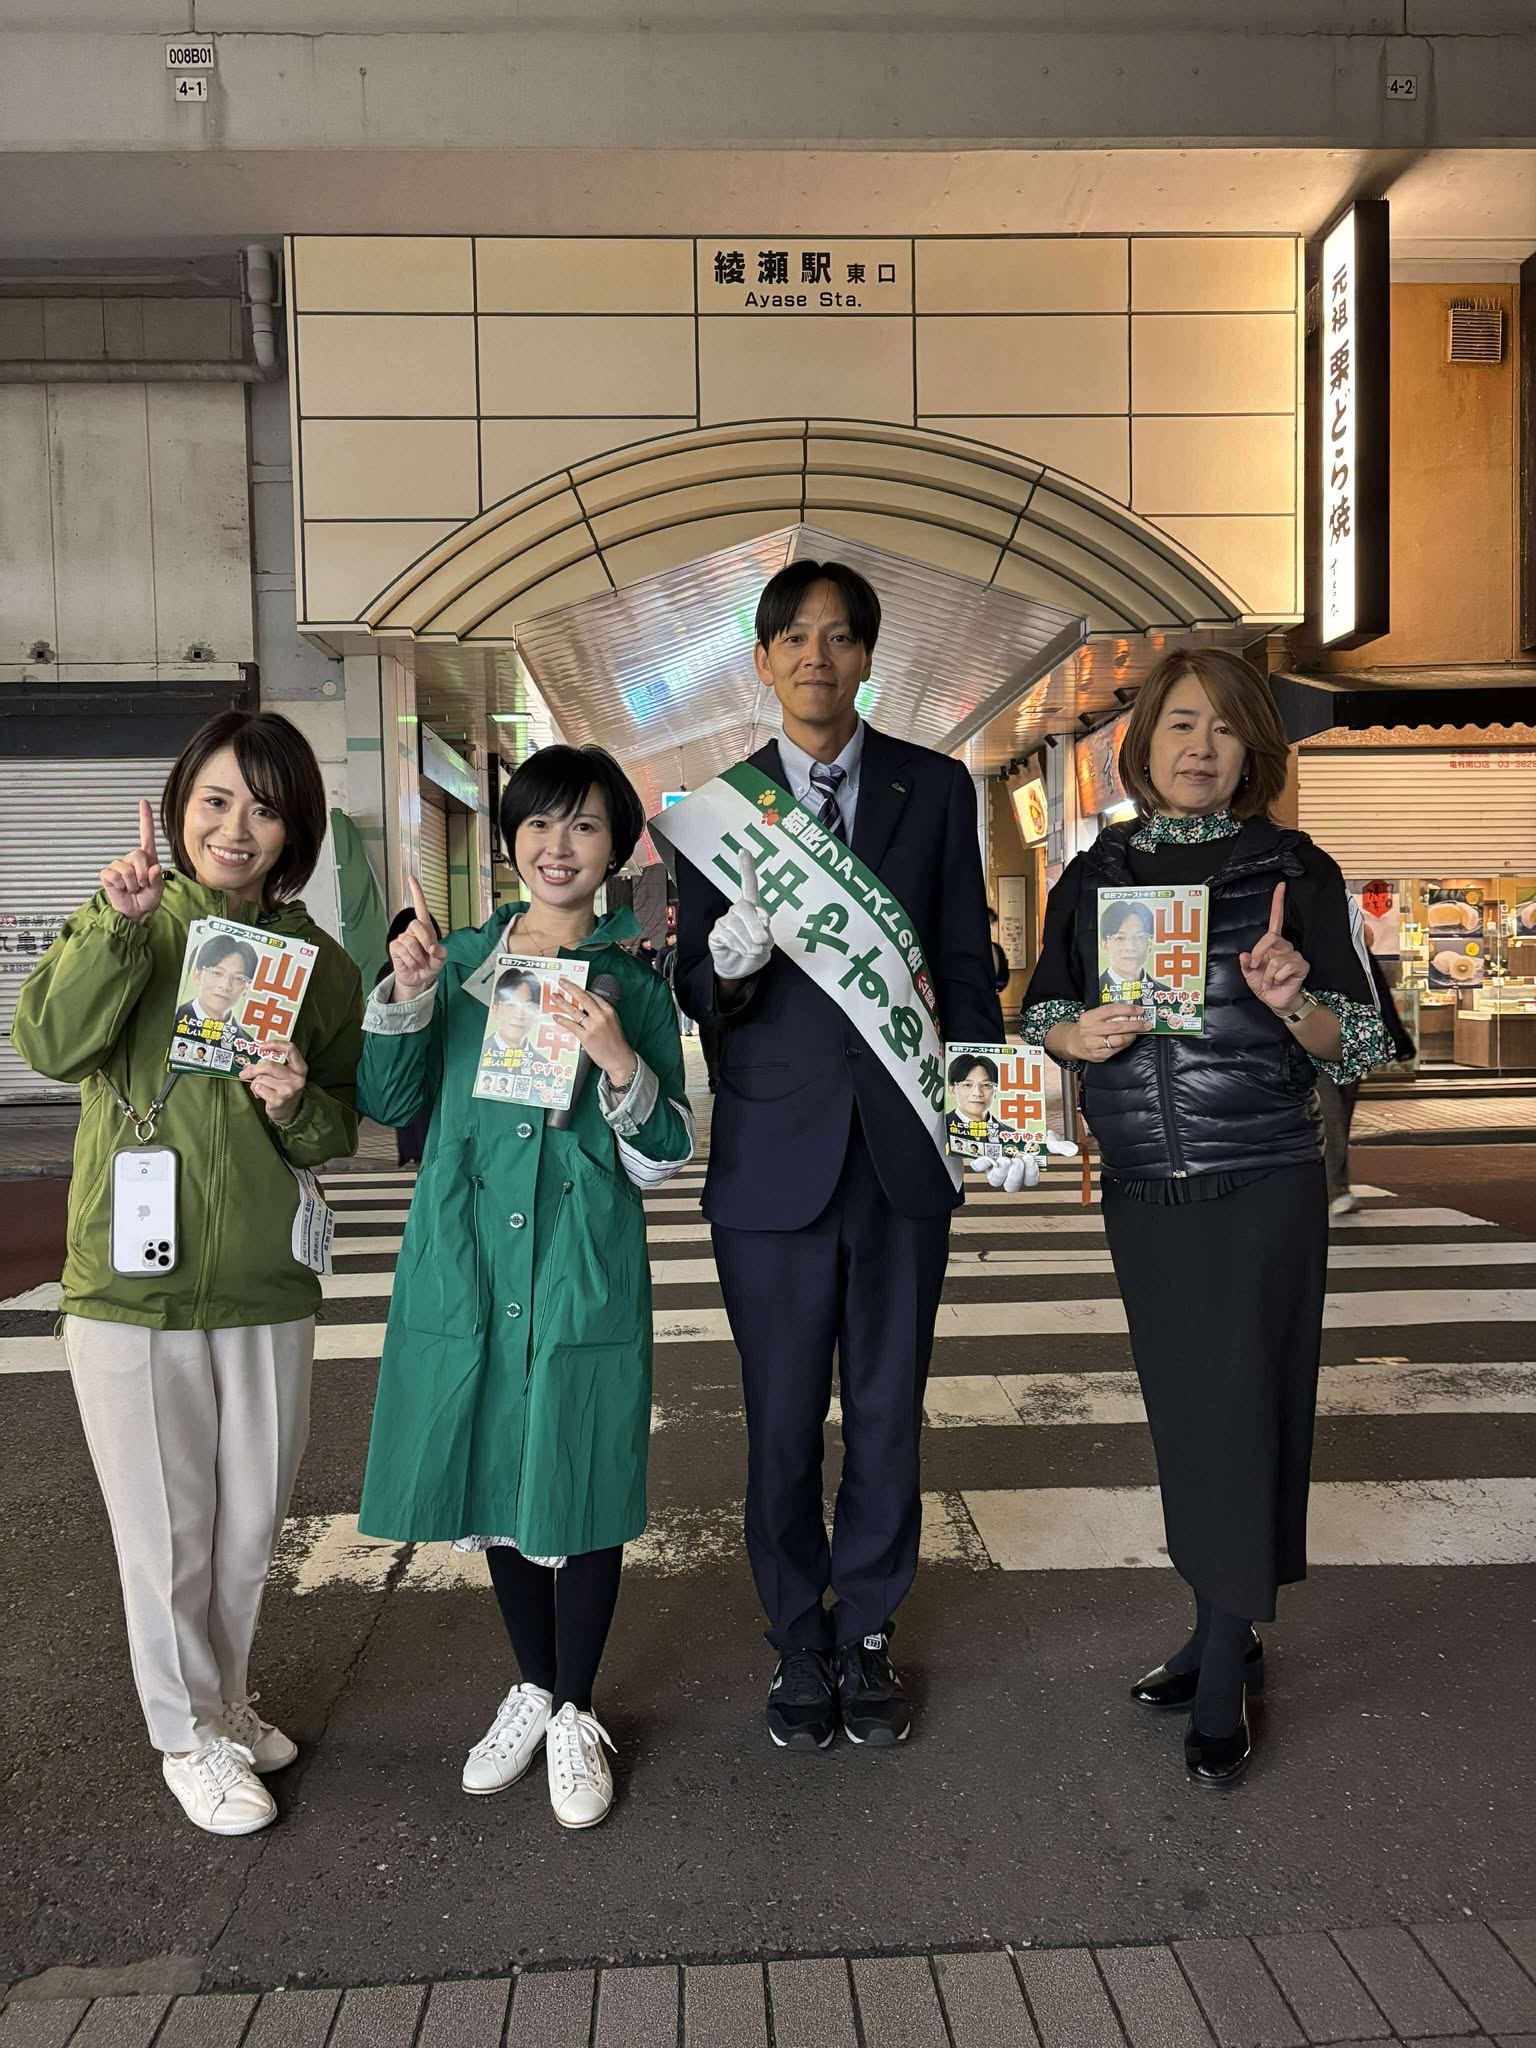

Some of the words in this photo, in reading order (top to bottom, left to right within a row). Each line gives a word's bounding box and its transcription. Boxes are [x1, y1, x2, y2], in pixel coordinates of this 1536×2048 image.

[169, 48, 212, 64] 008B01
[179, 81, 202, 96] 4-1
[1390, 79, 1413, 94] 4-2
[714, 250, 832, 284] 綾瀬駅
[846, 263, 896, 284] 東口
[744, 292, 807, 308] Ayase
[819, 292, 862, 307] Sta.
[1331, 263, 1349, 334] 元祖
[781, 806, 924, 974] 都民ファーストの会
[1155, 900, 1201, 988] 山中
[242, 952, 308, 1042] 山中
[1155, 990, 1201, 1003] やすゆき
[533, 1062, 574, 1077] やすゆき
[1000, 1057, 1042, 1130] 山中
[1001, 1131, 1044, 1142] やすゆき
